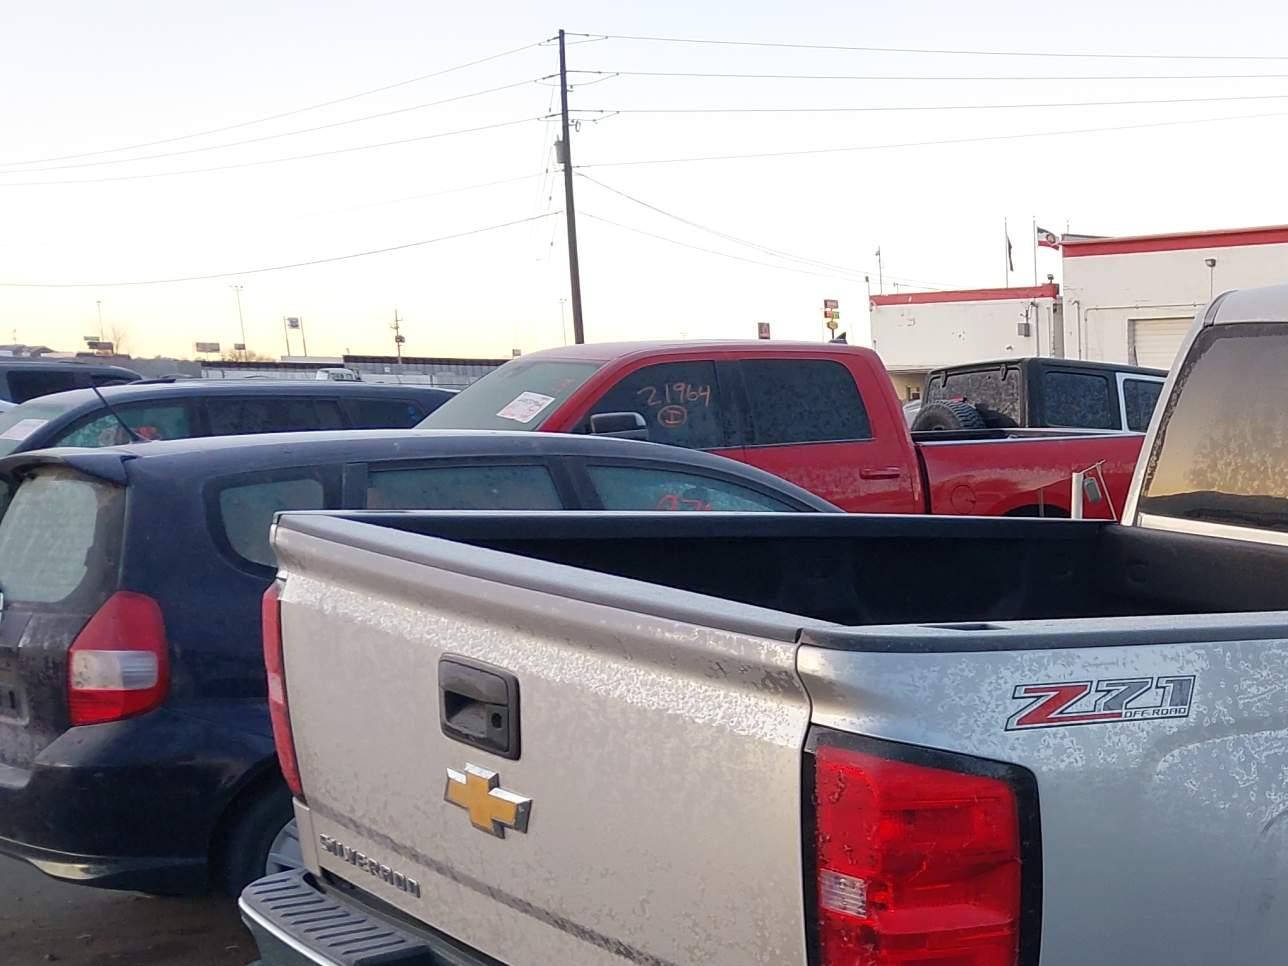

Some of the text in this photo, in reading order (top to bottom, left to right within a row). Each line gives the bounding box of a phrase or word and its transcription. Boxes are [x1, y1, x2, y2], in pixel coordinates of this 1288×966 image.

[637, 382, 711, 408] 21964
[1004, 675, 1196, 732] Z71
[1124, 706, 1187, 719] OFF ROAD
